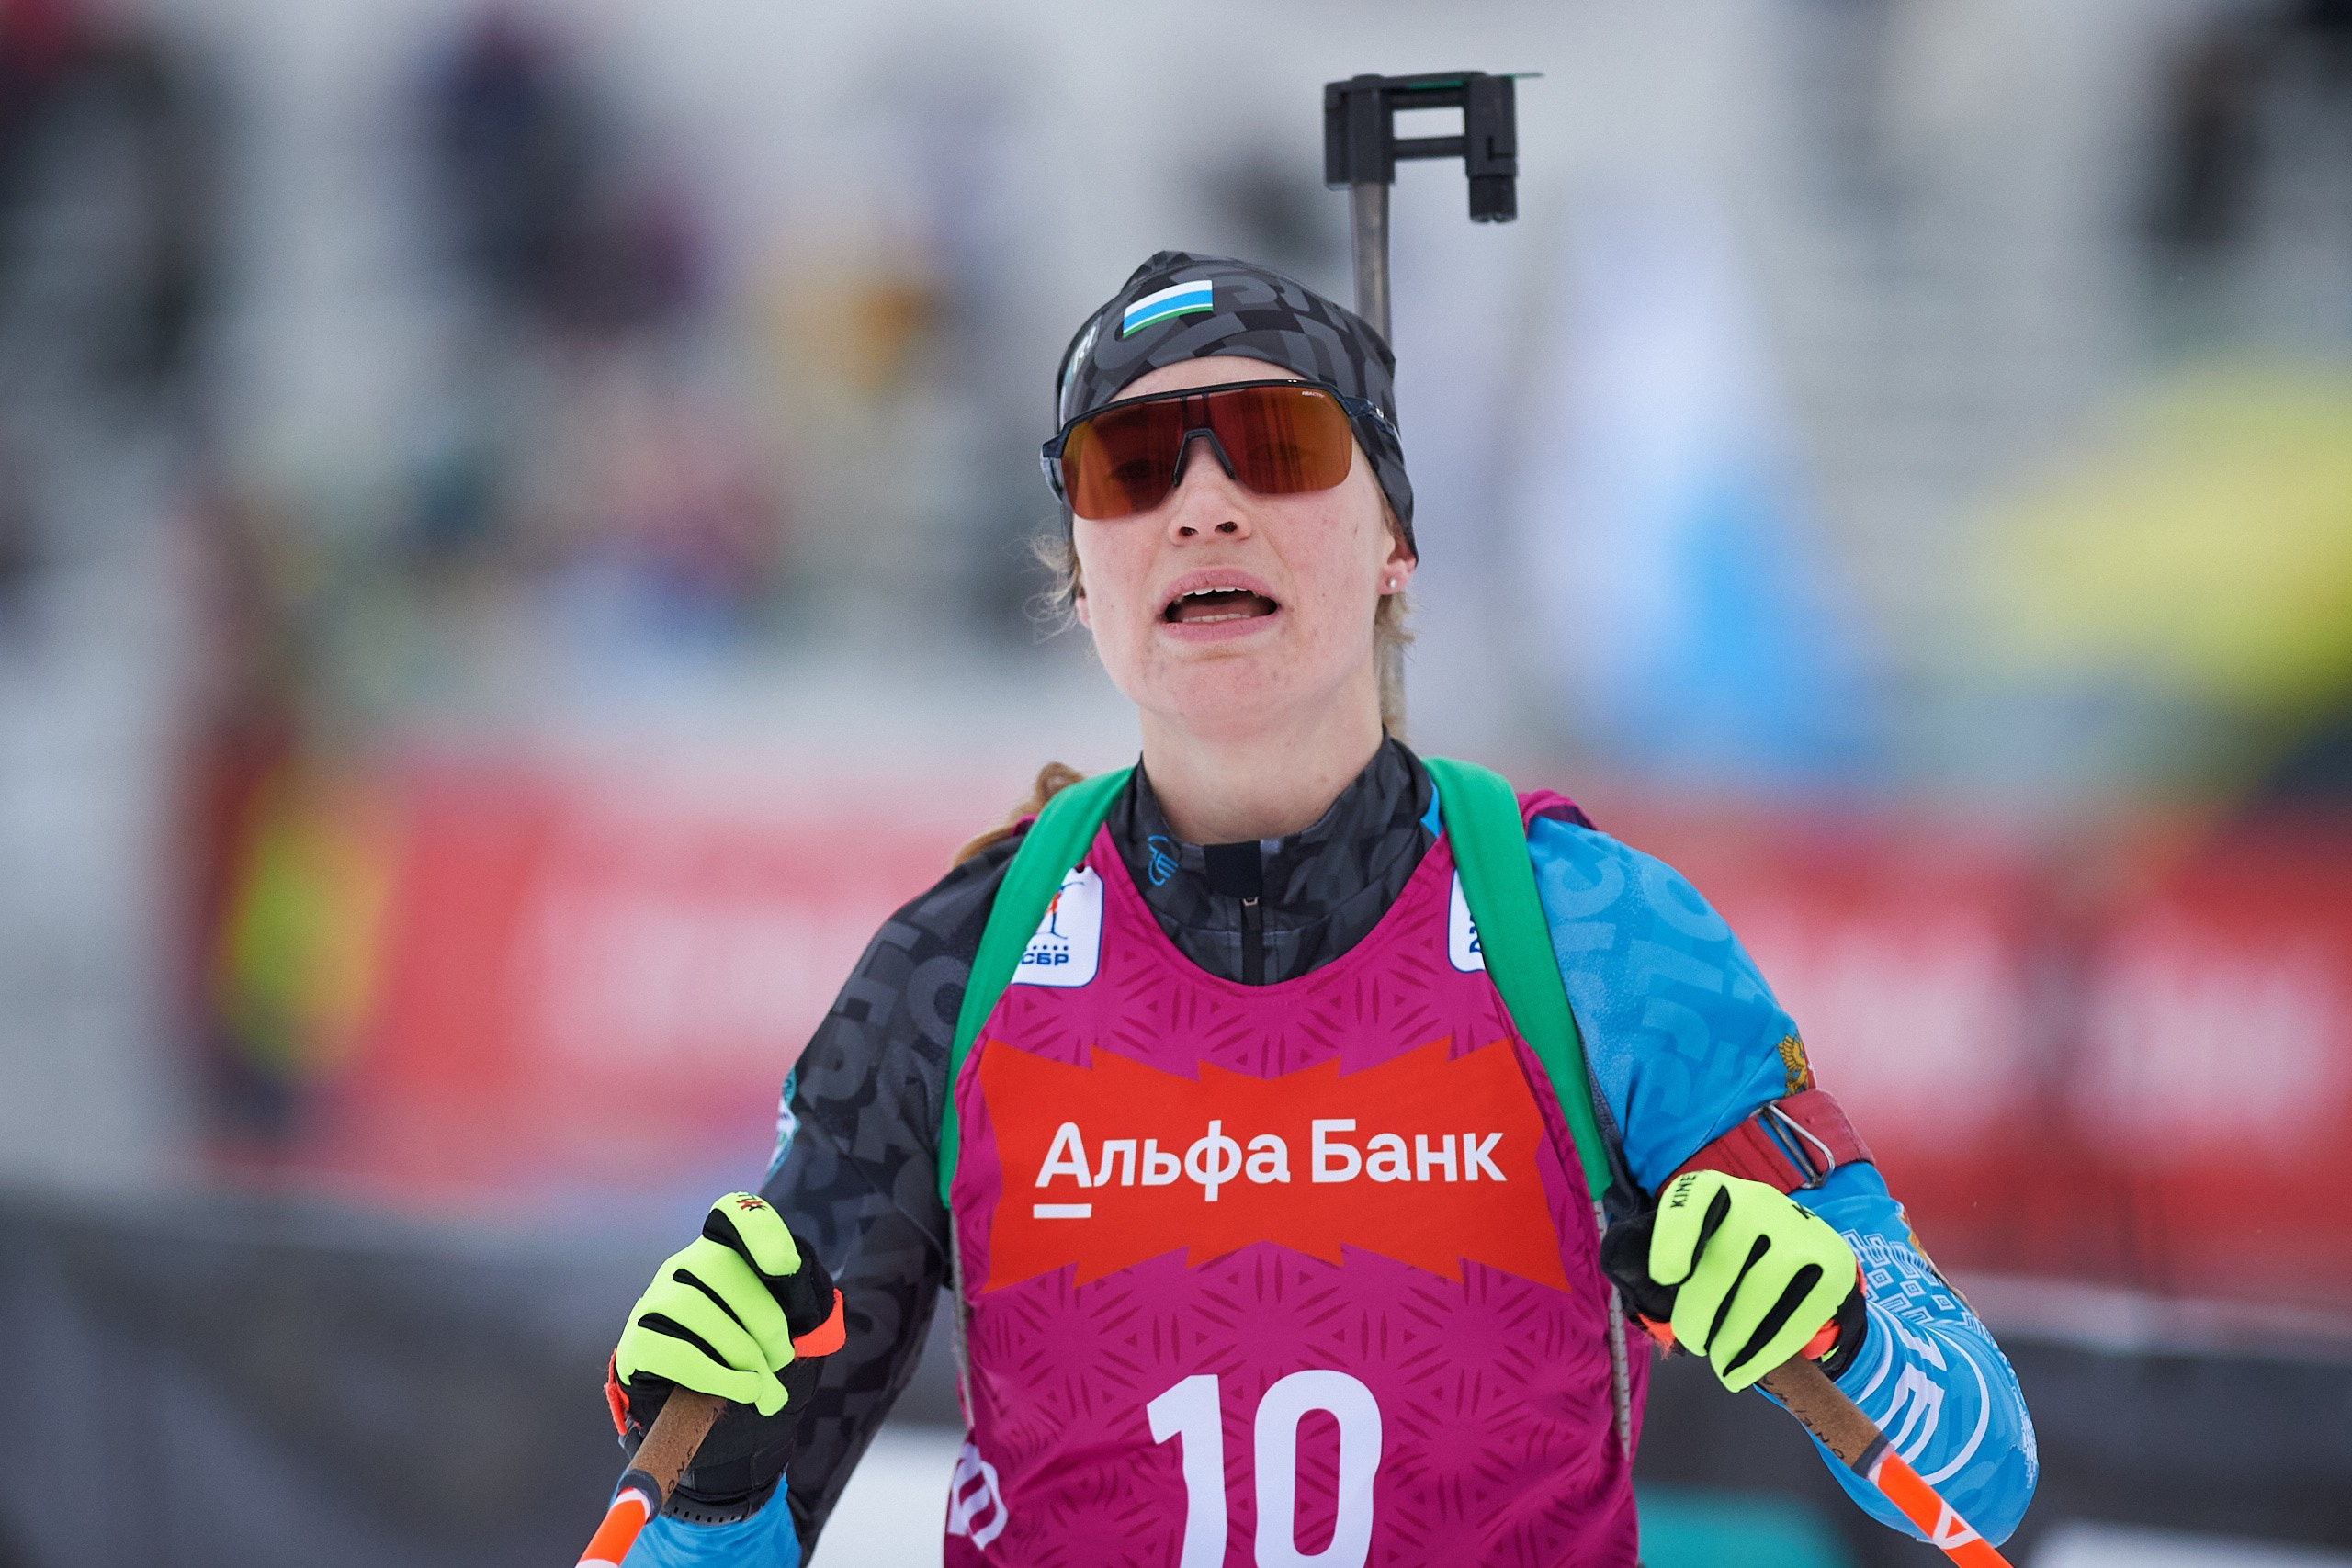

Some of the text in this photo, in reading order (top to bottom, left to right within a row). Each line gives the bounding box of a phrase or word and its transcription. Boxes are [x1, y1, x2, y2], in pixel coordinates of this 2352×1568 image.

[1021, 953, 1069, 966] СБР
[1033, 1118, 1508, 1203] Альфа Банк
[1146, 1369, 1383, 1568] 10
